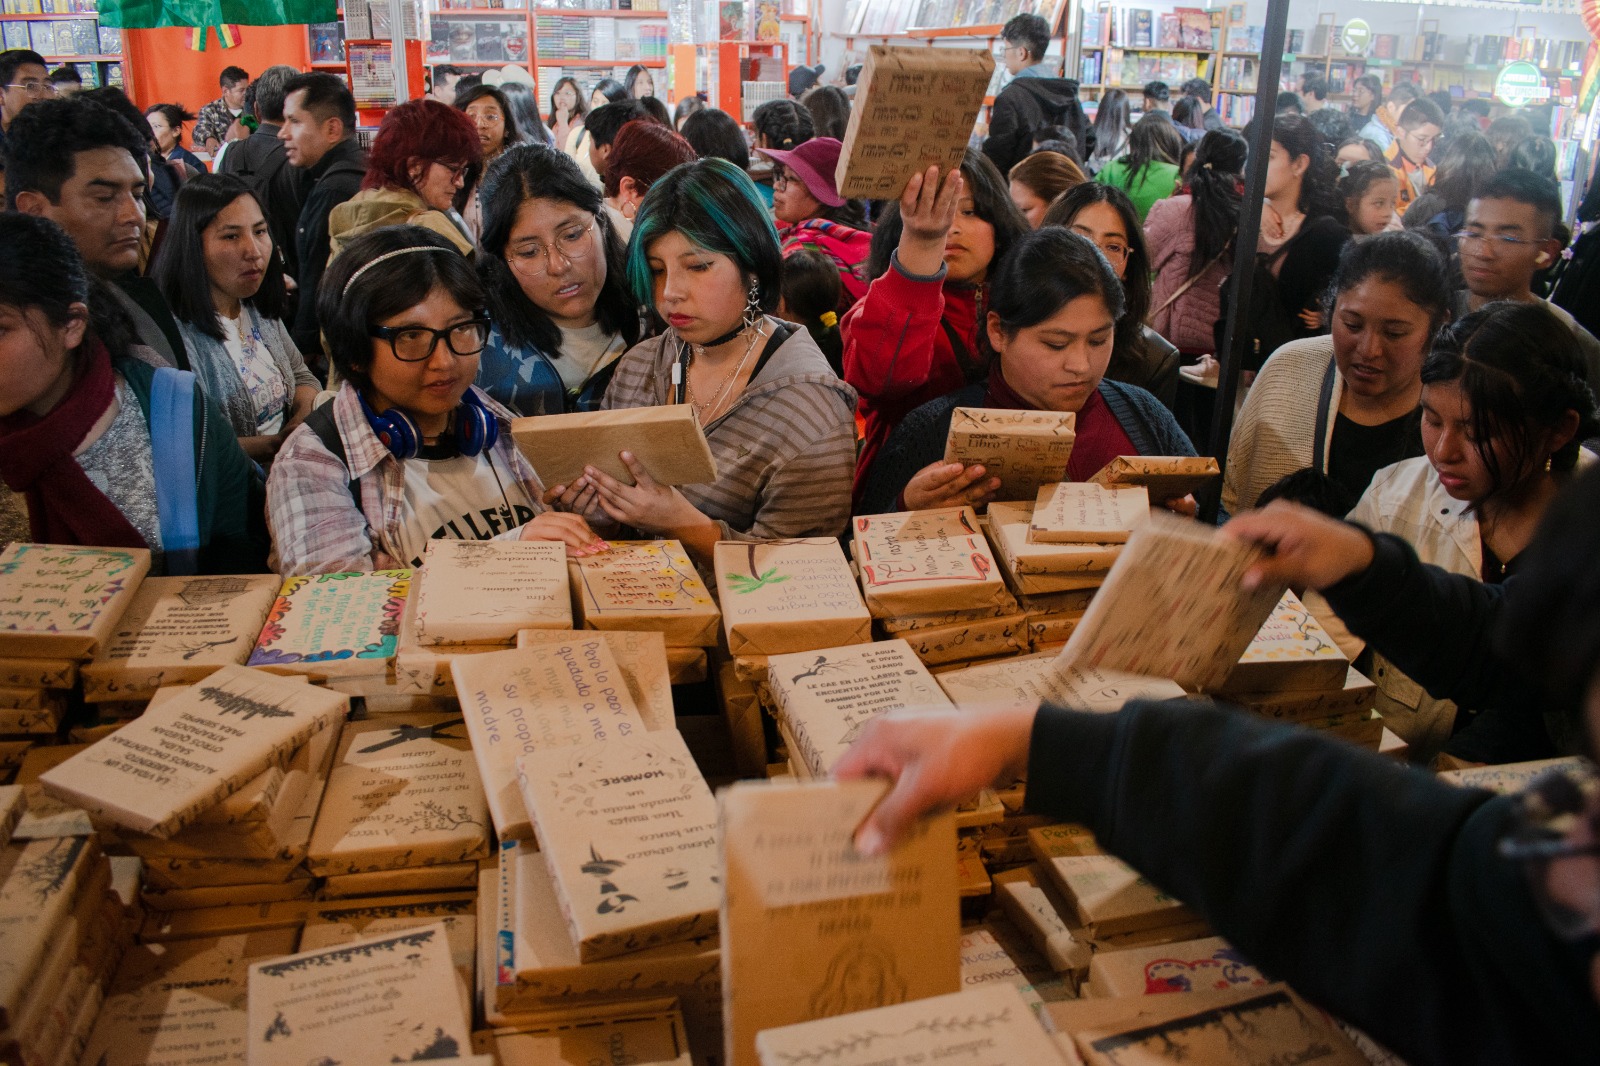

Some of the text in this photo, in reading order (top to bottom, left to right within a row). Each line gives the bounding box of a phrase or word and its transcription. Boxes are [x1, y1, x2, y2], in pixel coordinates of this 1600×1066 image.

[968, 438, 1000, 448] Libro
[554, 645, 591, 698] quedado
[870, 662, 903, 671] CUANDO
[872, 671, 901, 681] LABIOS
[582, 641, 601, 669] Pero
[600, 687, 628, 717] peor
[618, 722, 633, 737] es
[815, 679, 902, 697] ENCUENTRA NUEVOS
[824, 694, 862, 704] CAMINOS
[857, 696, 897, 707] RECORRE
[871, 703, 905, 713] ROSTRO
[474, 689, 502, 747] madre
[599, 769, 664, 787] HOMBRE
